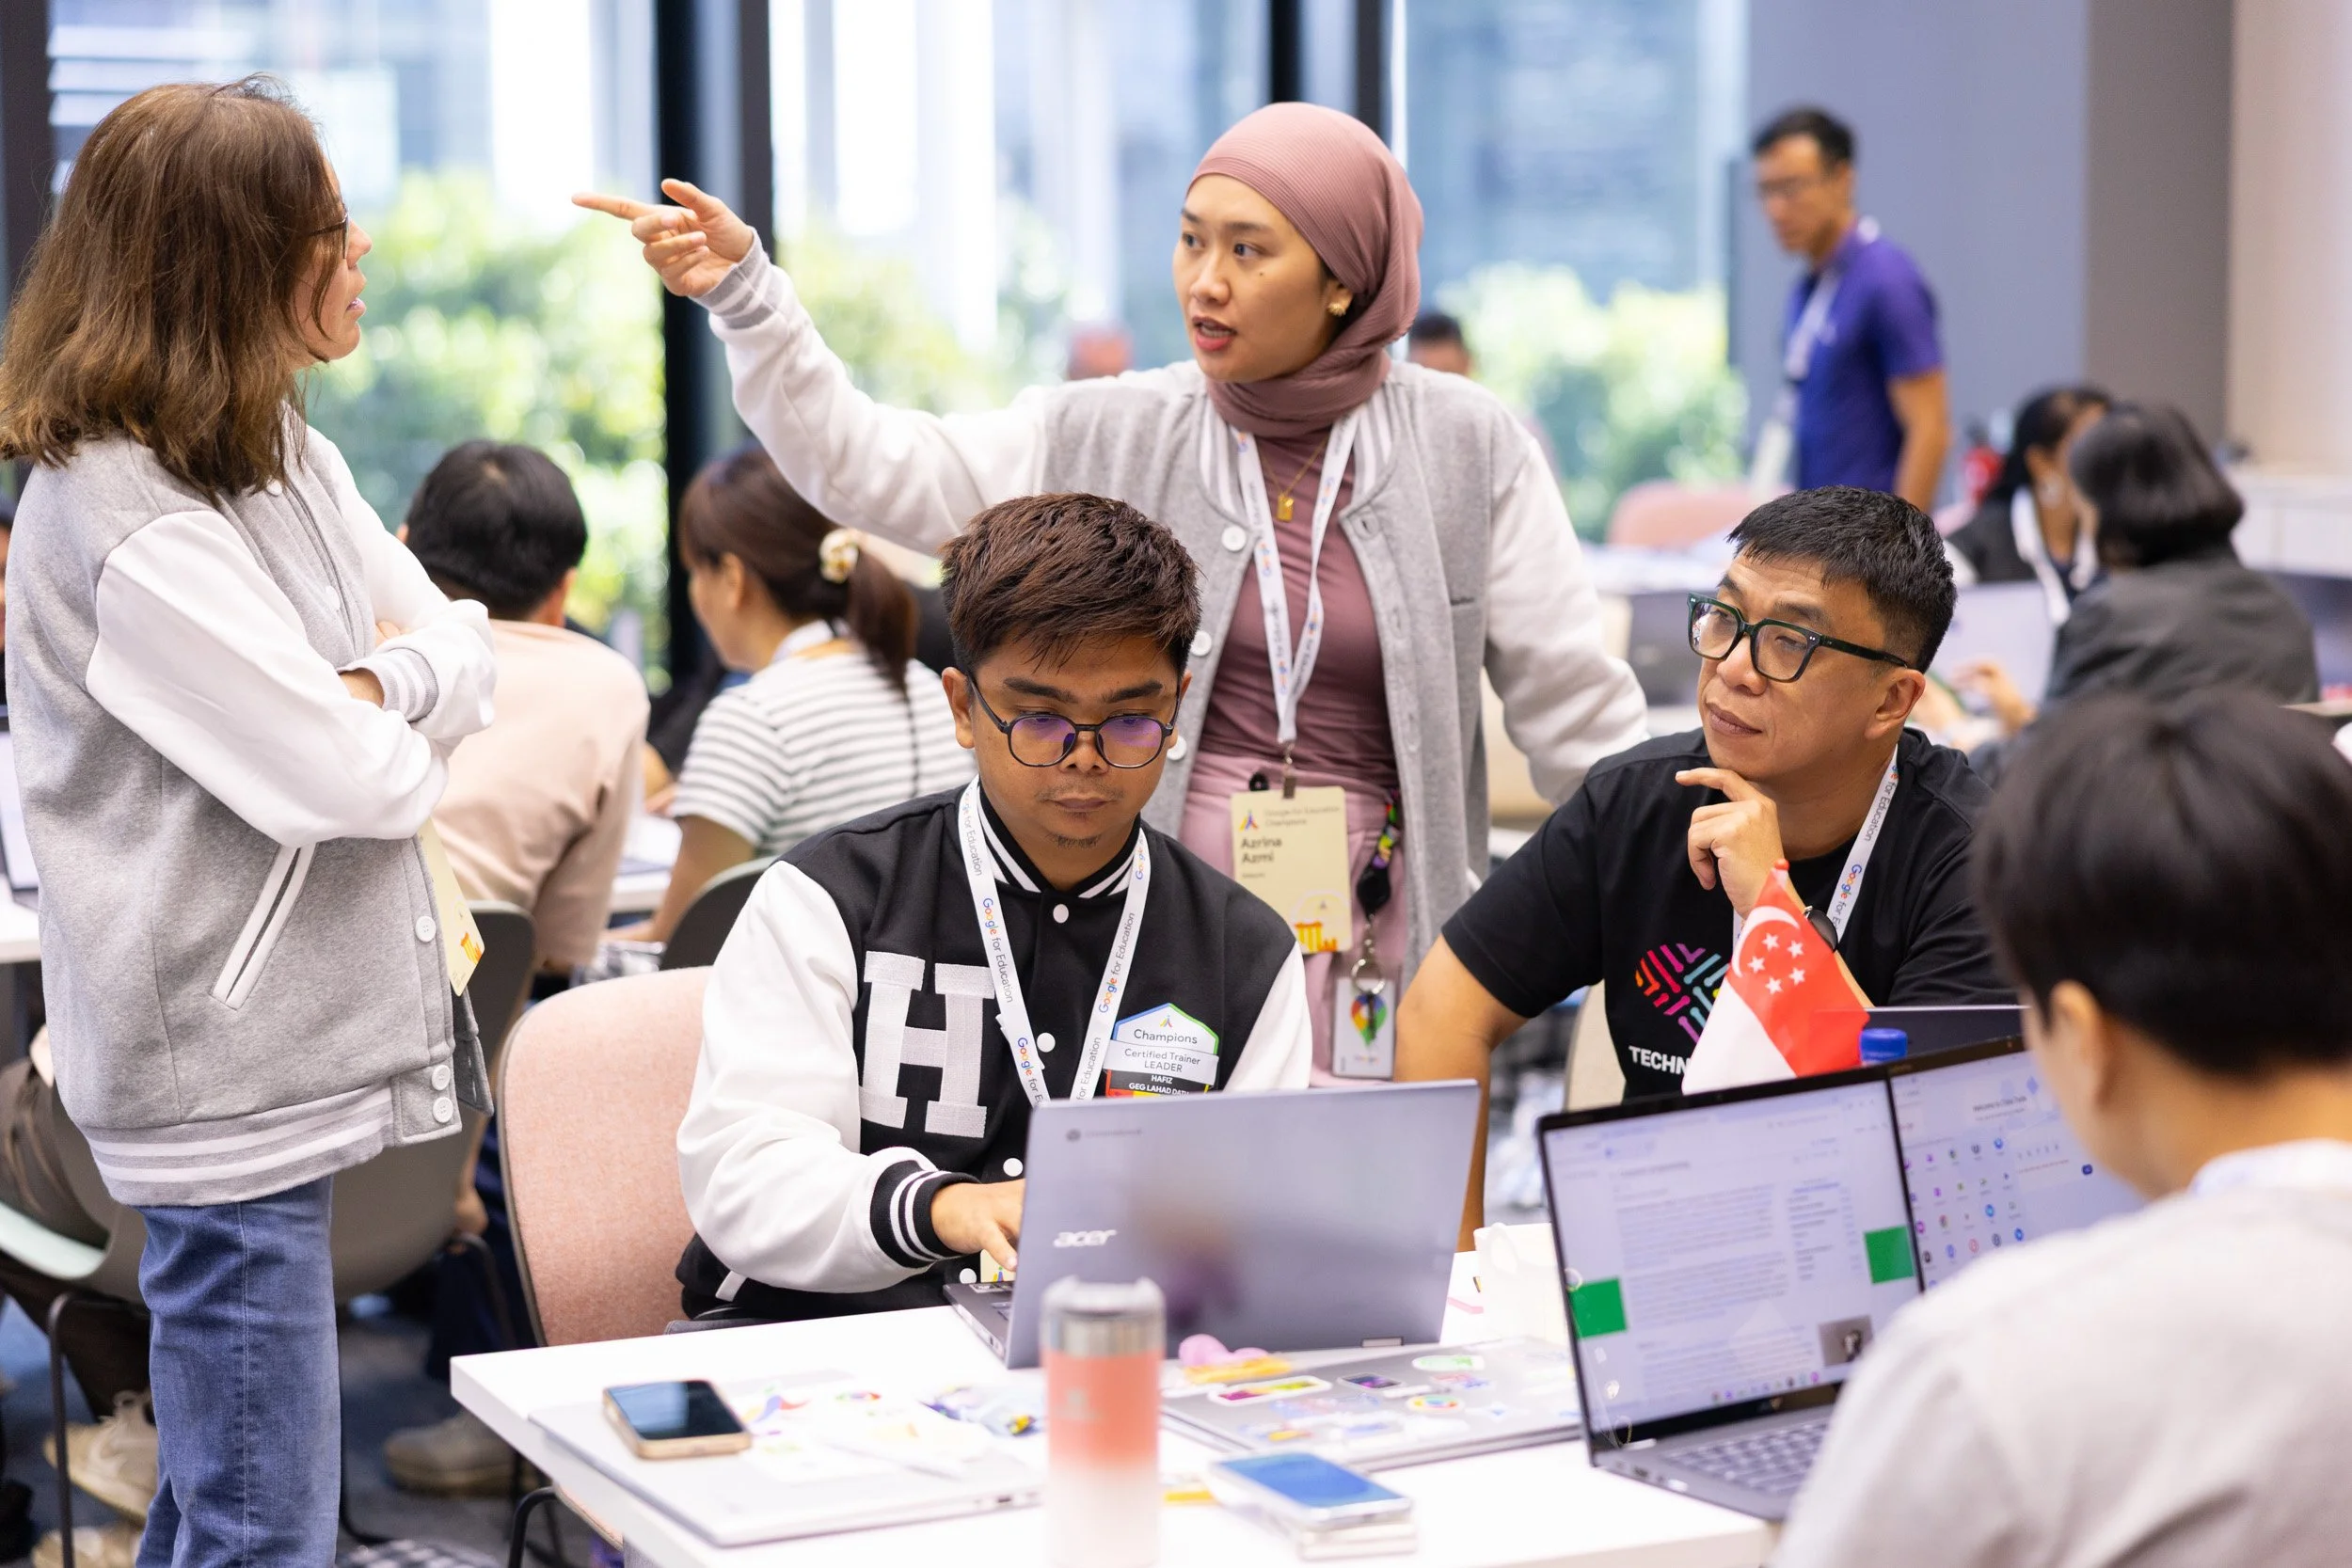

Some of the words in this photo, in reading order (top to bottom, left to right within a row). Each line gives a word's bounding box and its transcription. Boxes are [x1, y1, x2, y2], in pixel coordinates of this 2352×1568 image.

[1884, 781, 1898, 796] for
[1865, 797, 1891, 842] Education
[966, 830, 983, 877] Education
[1841, 863, 1863, 899] Google
[983, 897, 998, 936] Google
[1836, 900, 1846, 916] for
[991, 937, 1002, 952] for
[1115, 912, 1135, 958] Education
[1110, 959, 1122, 975] for
[995, 954, 1013, 1003] Education
[1099, 977, 1118, 1013] Google
[1134, 1028, 1198, 1044] Champions
[1017, 1037, 1034, 1076] Google
[1028, 1078, 1039, 1091] for
[1081, 1037, 1101, 1084] Education
[1124, 1048, 1168, 1060] Certified
[1170, 1053, 1200, 1066] Trainer
[1144, 1060, 1183, 1073] LEADER
[1129, 1083, 1146, 1091] GEG
[1146, 1085, 1171, 1094] LAHAD
[1151, 1074, 1173, 1085] HAFIZ
[1075, 1085, 1088, 1101] for
[1054, 1228, 1118, 1248] acer
